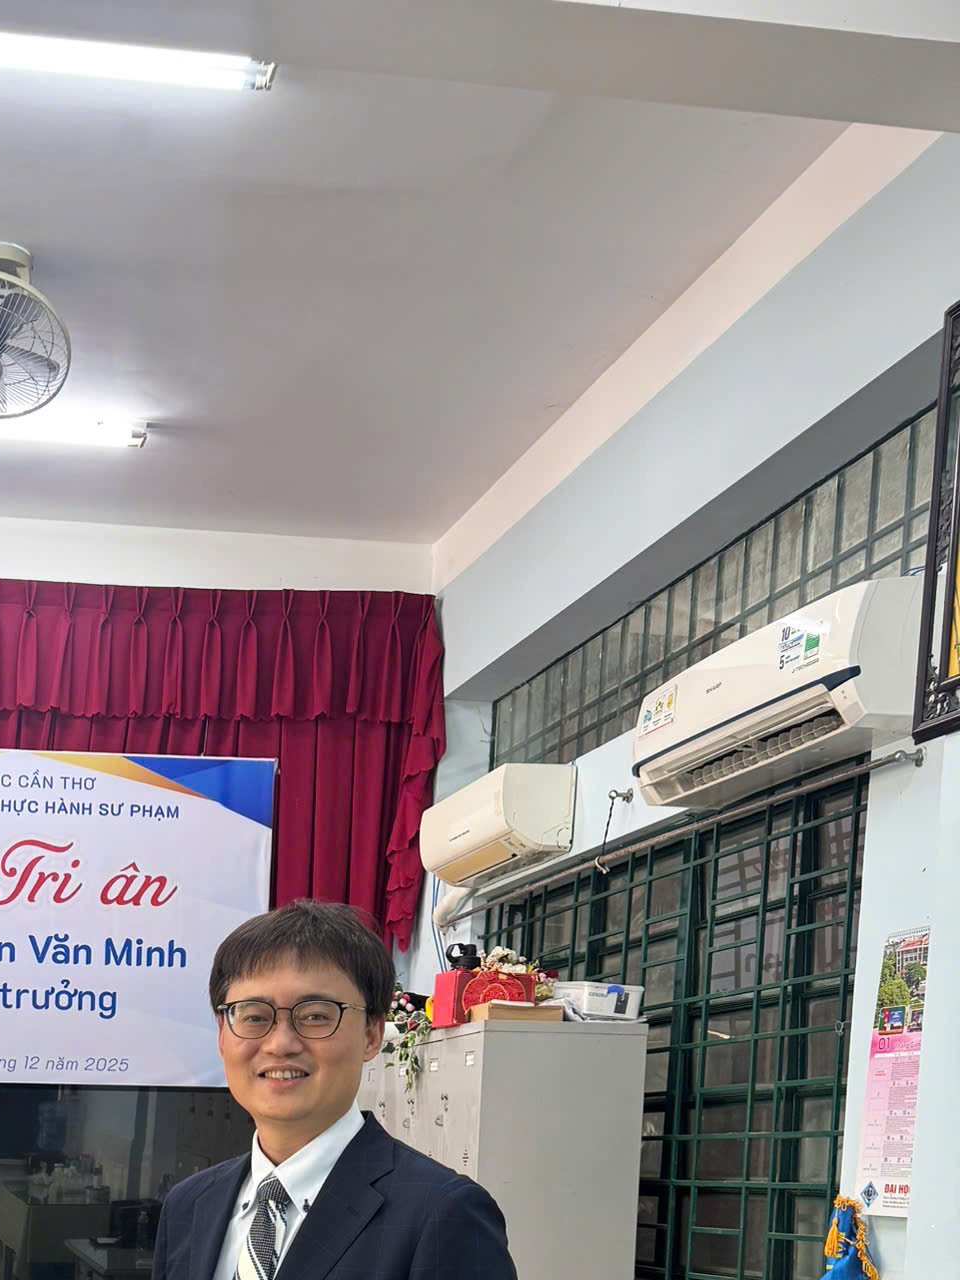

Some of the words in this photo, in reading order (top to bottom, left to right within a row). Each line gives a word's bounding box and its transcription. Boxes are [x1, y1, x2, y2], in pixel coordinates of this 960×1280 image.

[782, 626, 791, 642] 10
[18, 769, 54, 789] CẦN
[60, 776, 96, 791] THƠ
[45, 798, 92, 815] HÀNH
[98, 802, 124, 817] SƯ
[130, 804, 180, 821] PHẠM
[101, 862, 177, 907] ân
[29, 933, 92, 966] Văn
[104, 937, 188, 969] Minh
[0, 979, 118, 1019] trưởng
[878, 1037, 890, 1050] 01
[24, 1055, 40, 1070] 12
[45, 1057, 79, 1071] năm
[84, 1057, 129, 1072] 2025
[898, 1184, 910, 1196] HỌ
